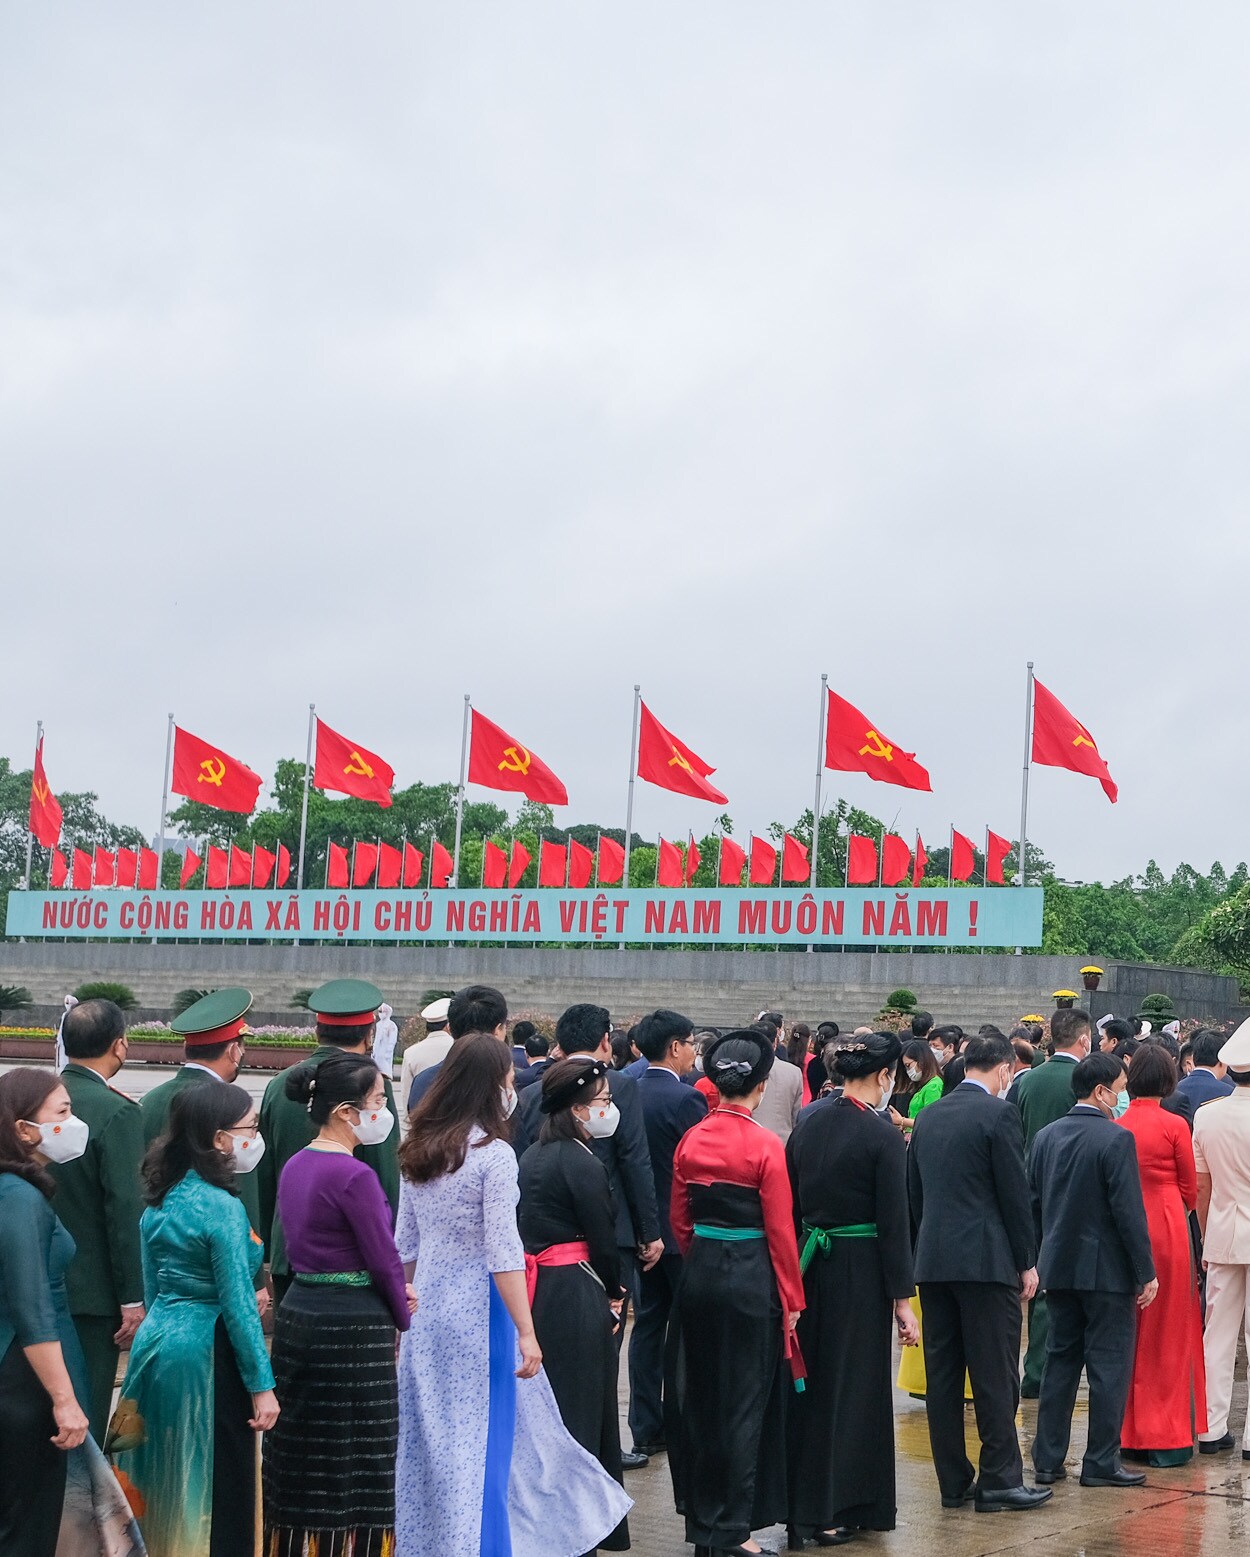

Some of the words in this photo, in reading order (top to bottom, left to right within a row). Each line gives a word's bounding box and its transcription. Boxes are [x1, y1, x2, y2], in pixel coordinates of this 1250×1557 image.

[42, 895, 108, 929] NƯỚC
[120, 895, 189, 935] CỘNG
[200, 895, 253, 930] HÒA
[265, 895, 301, 931] XÃ
[313, 895, 362, 937] HỘI
[374, 891, 433, 932] CHỦ
[446, 894, 541, 933] NGHĨA
[559, 894, 630, 940] VIỆT
[644, 900, 722, 934] NAM
[738, 894, 845, 936] MUÔN
[862, 894, 948, 937] NĂM
